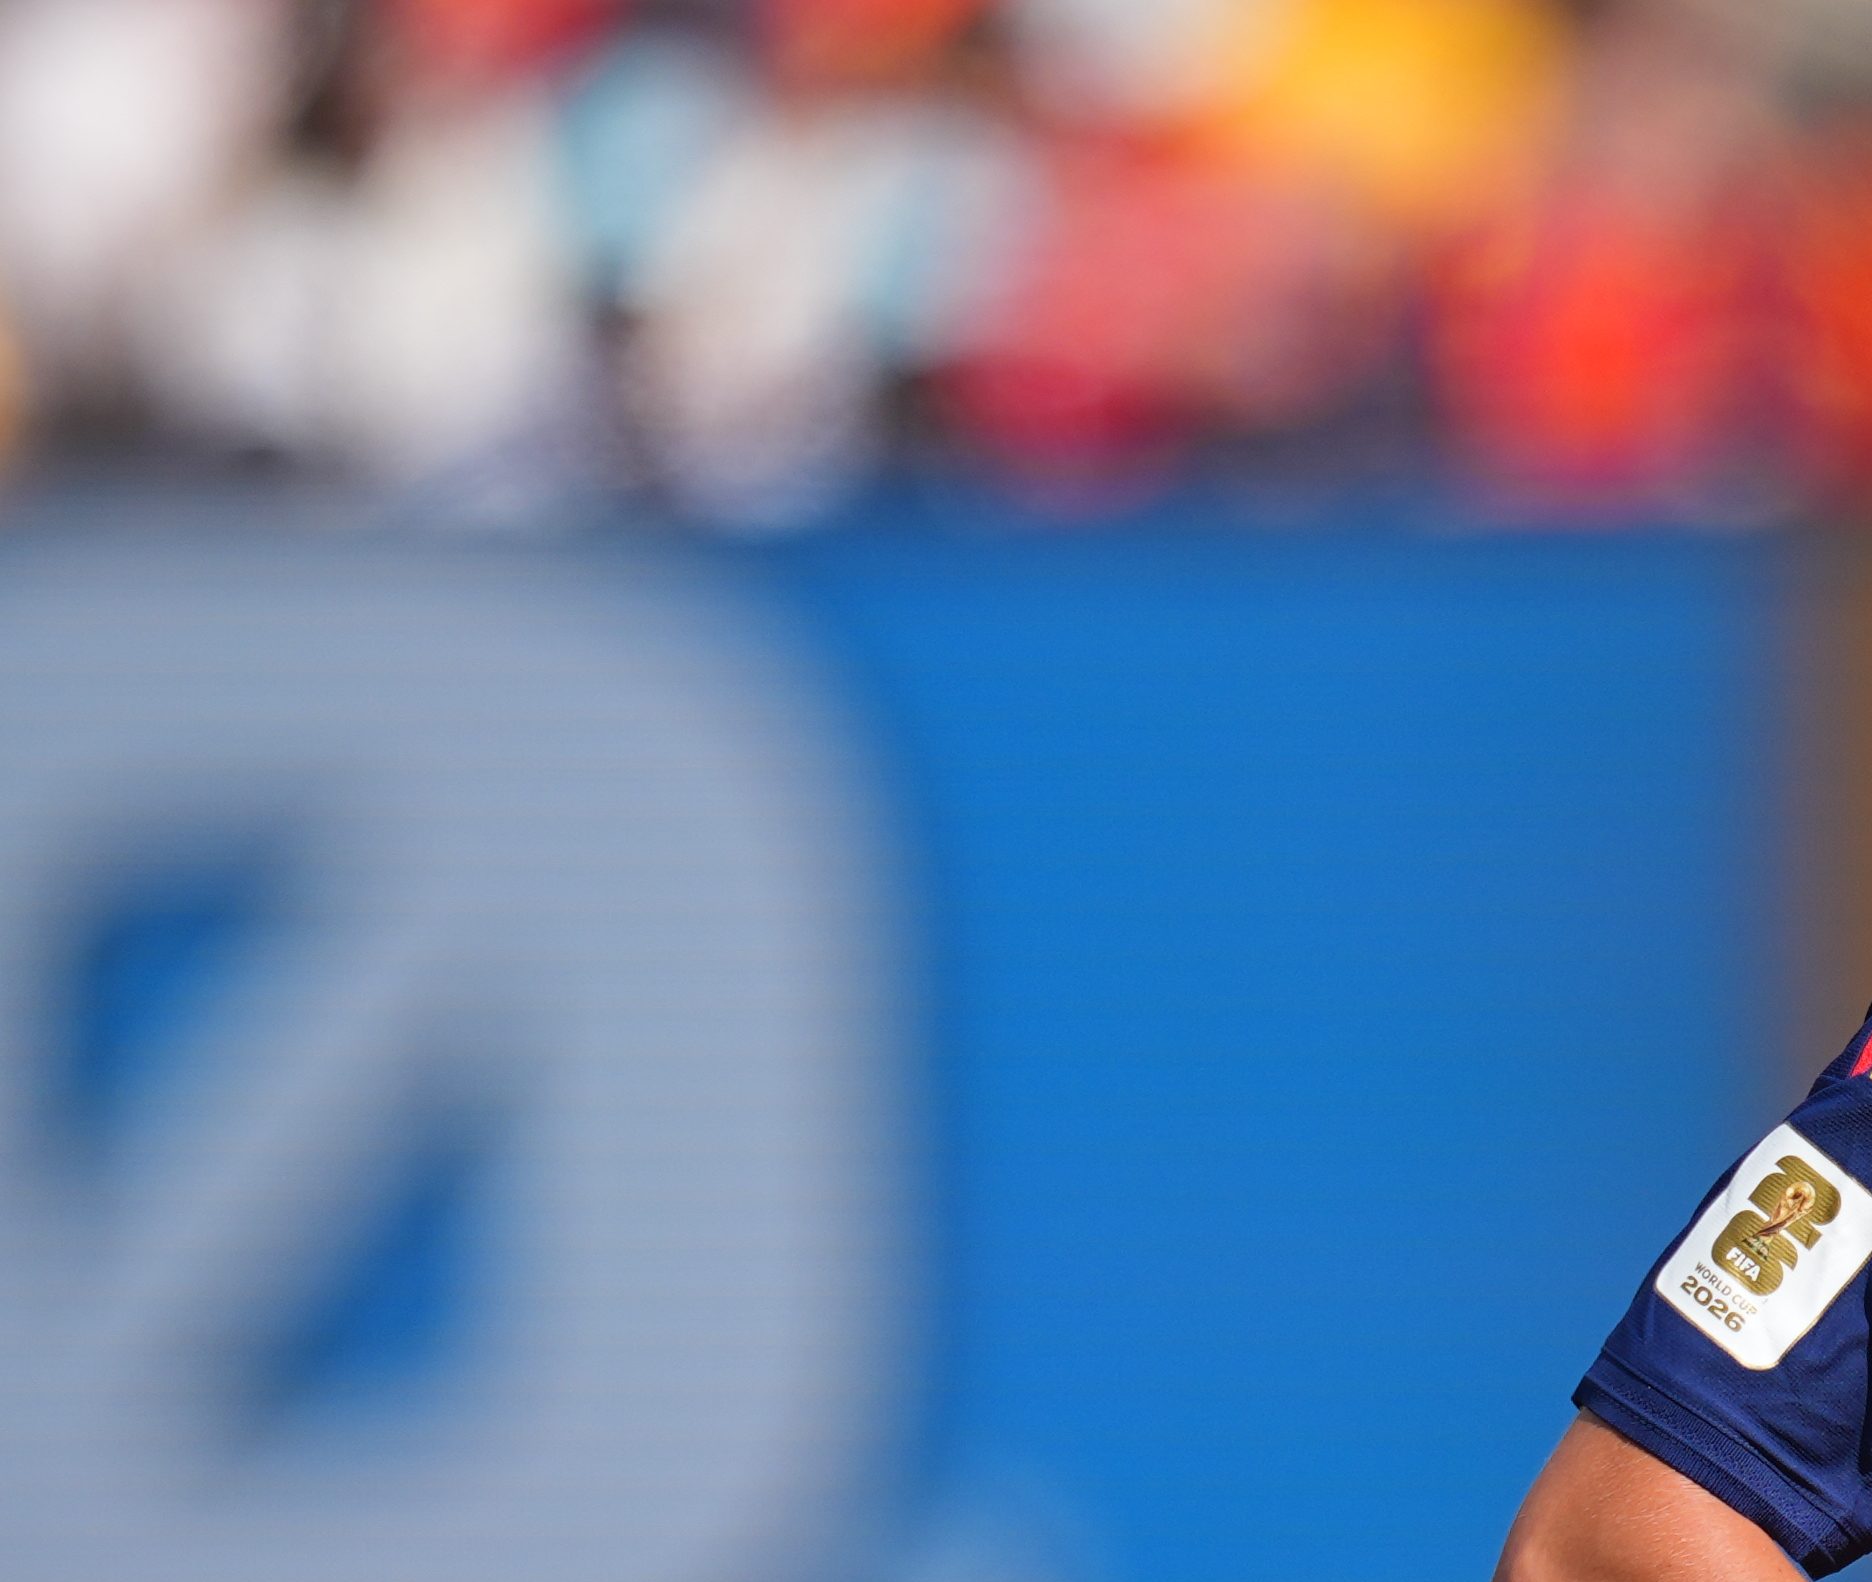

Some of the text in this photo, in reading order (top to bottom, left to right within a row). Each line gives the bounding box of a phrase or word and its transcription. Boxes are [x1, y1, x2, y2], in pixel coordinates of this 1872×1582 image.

[1695, 1261, 1758, 1315] WORLD CUP
[1725, 1247, 1760, 1282] FIFA
[1681, 1275, 1746, 1333] 2026
